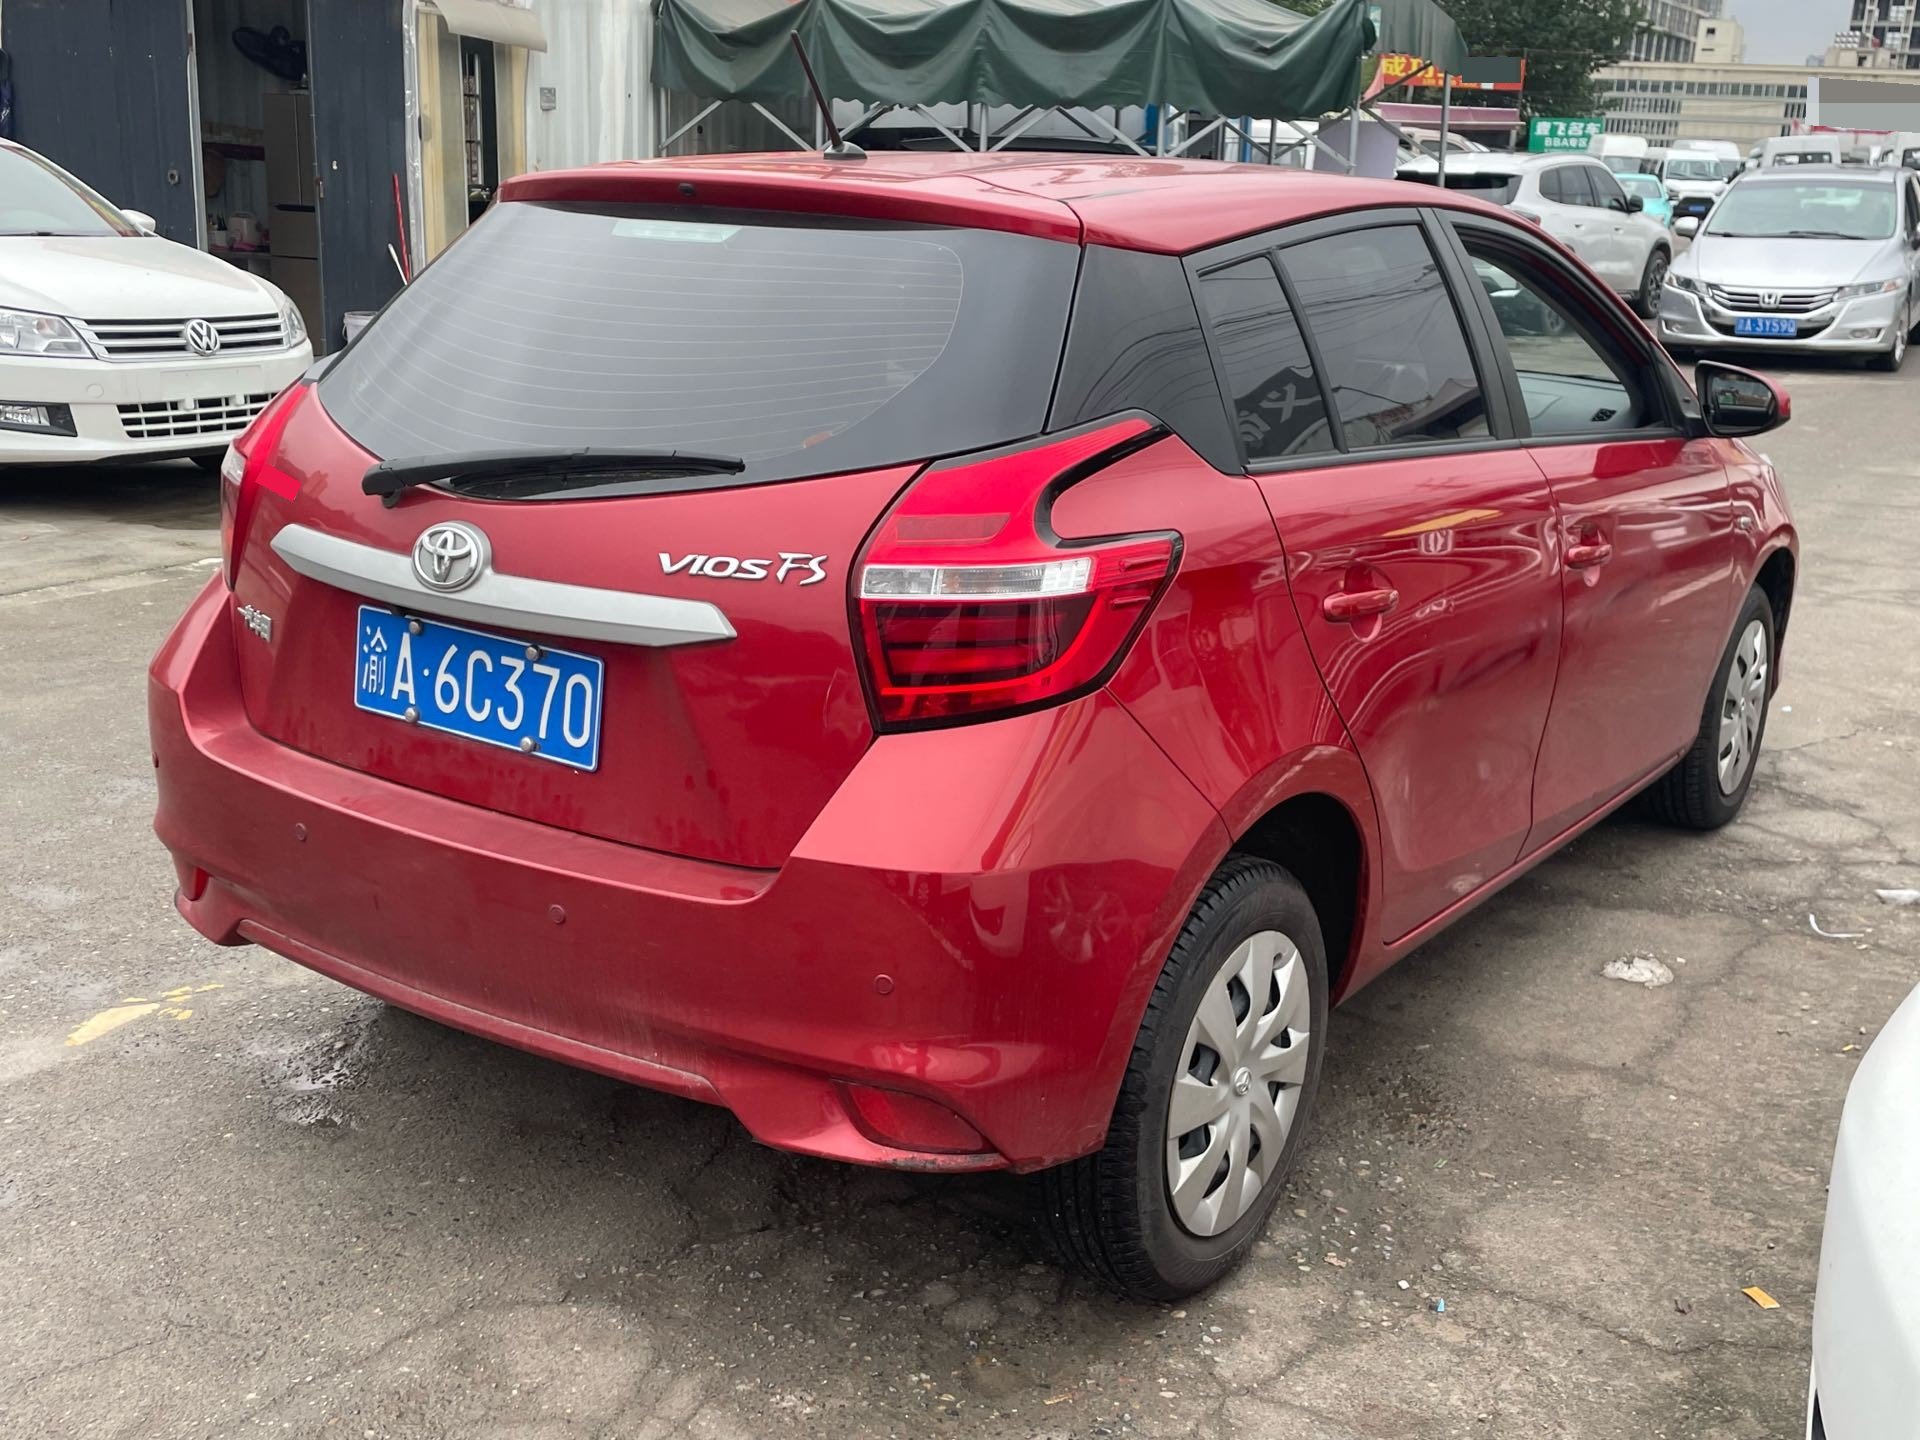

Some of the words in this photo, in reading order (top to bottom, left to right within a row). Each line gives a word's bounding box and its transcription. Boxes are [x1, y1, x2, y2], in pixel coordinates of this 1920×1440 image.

[658, 552, 774, 580] VIOS
[776, 551, 828, 586] FS
[362, 626, 594, 748] 渝A·6C370
